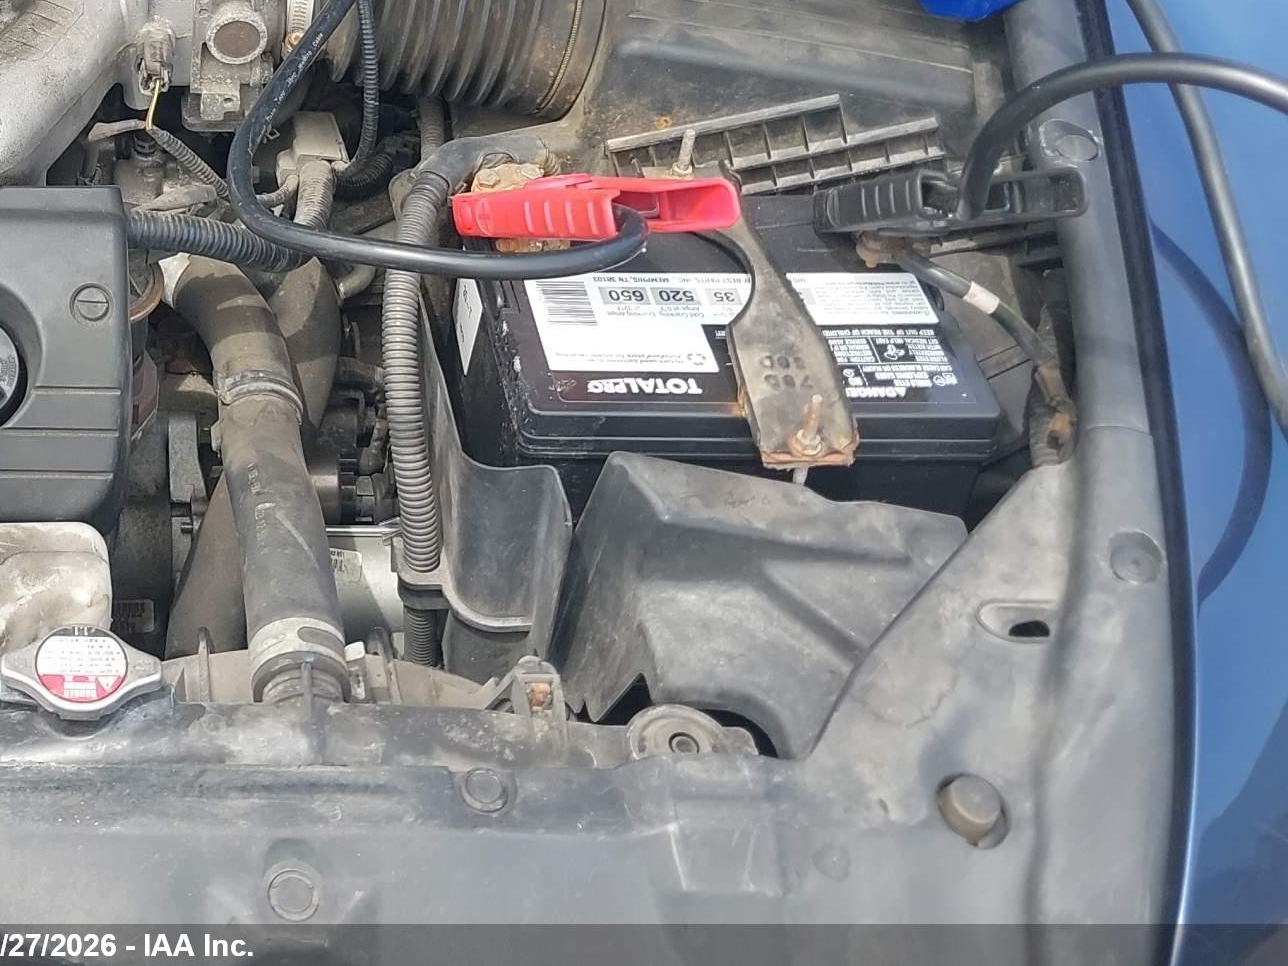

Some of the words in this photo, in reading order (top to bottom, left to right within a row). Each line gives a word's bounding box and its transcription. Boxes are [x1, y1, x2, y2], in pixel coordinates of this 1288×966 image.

[608, 289, 643, 301] 650
[658, 290, 694, 301] 520
[713, 291, 734, 301] 35
[586, 377, 702, 394] TOTALPRO
[74, 626, 88, 635] 1.1
